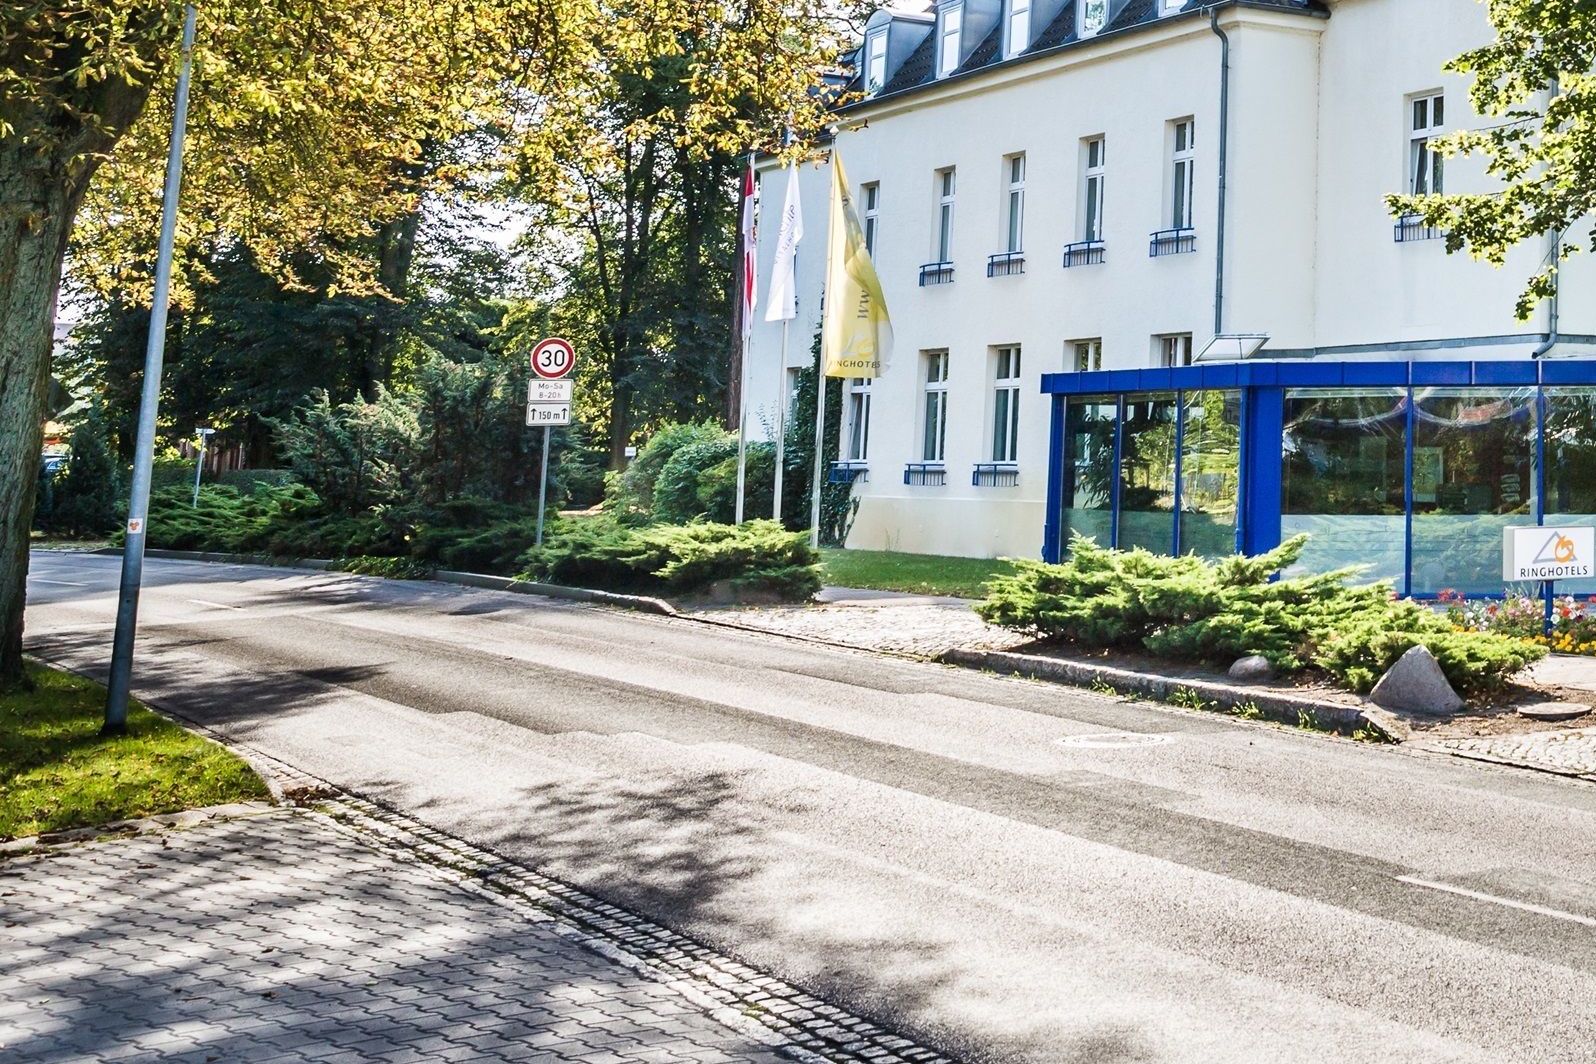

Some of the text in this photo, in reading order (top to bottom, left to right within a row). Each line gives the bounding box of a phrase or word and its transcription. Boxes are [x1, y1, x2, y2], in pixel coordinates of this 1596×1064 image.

[541, 349, 565, 367] 30
[538, 382, 564, 390] Mo-Sa
[538, 411, 552, 420] 150
[1520, 565, 1588, 577] RINGHOTELS
